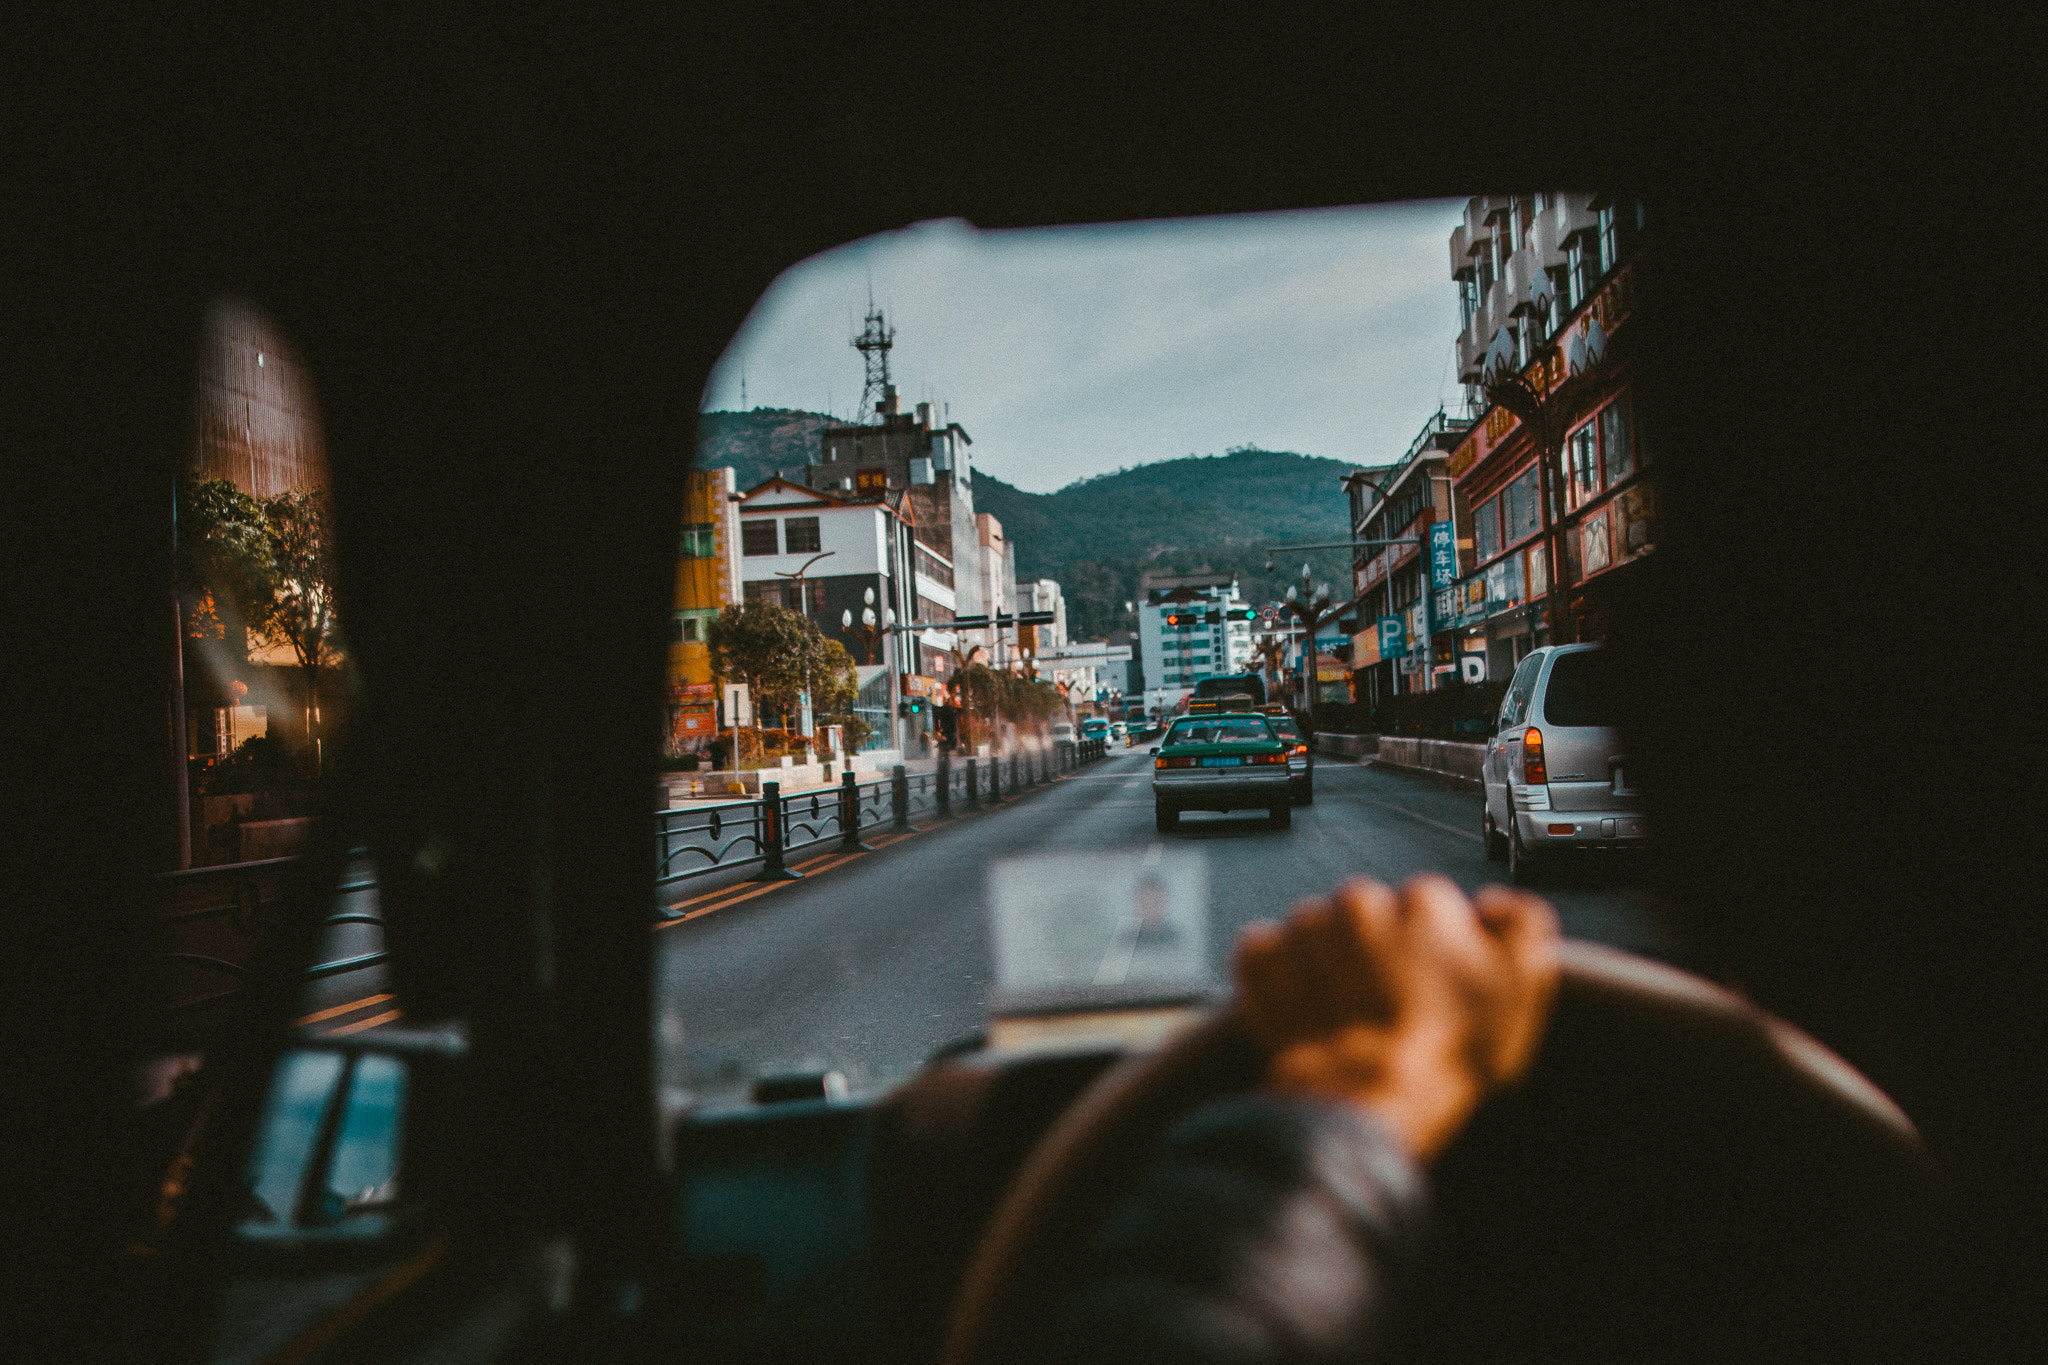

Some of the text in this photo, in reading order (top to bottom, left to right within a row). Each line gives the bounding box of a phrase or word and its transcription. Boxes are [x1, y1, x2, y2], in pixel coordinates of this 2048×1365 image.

[1433, 531, 1452, 585] 停车场
[1382, 619, 1402, 649] P
[1461, 656, 1485, 684] D
